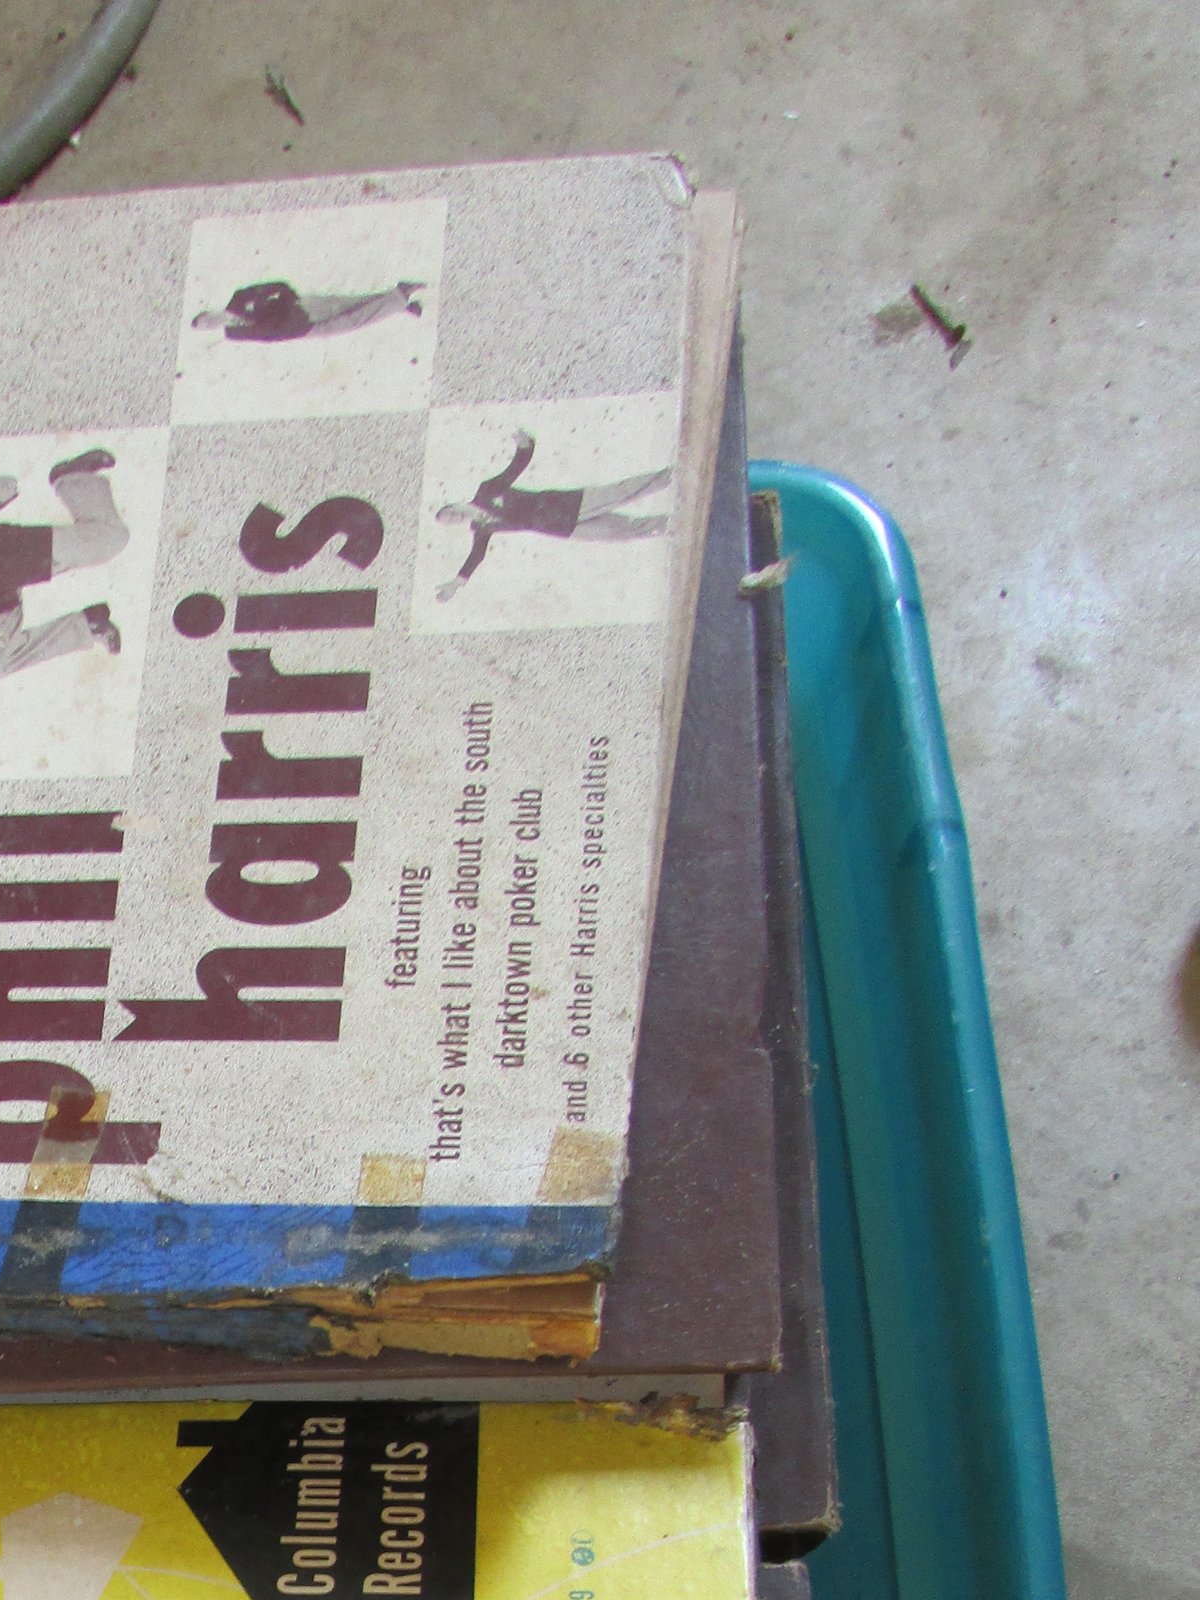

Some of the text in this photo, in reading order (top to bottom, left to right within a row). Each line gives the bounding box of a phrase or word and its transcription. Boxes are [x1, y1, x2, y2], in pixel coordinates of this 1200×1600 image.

[111, 494, 384, 1041] harris
[384, 864, 431, 988] featuring
[429, 699, 494, 1161] that's what I like about the south
[494, 787, 543, 1067] darktown poker club
[562, 734, 610, 1121] and 6 other Harris specialties
[275, 1415, 347, 1595] Columbia
[361, 1440, 429, 1594] Records
